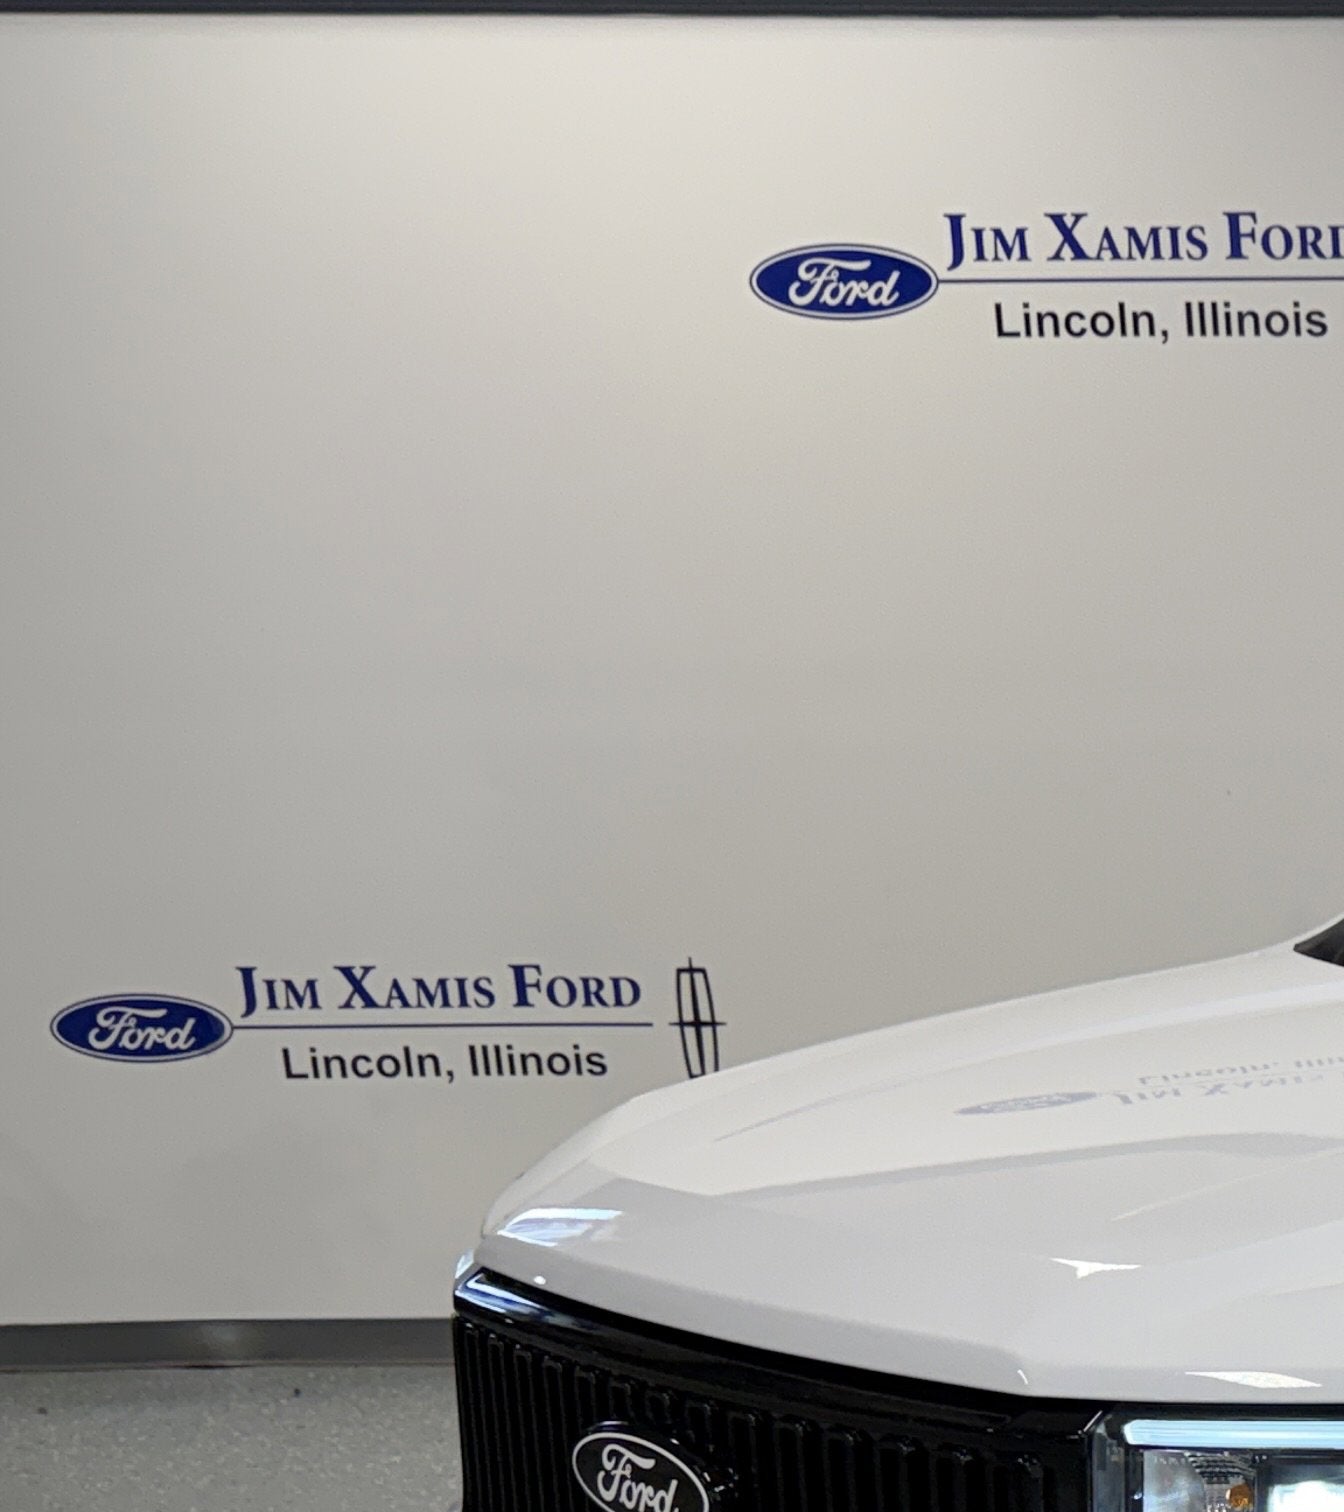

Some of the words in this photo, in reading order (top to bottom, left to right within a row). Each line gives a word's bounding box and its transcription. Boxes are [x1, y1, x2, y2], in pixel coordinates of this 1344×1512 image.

[943, 213, 1031, 272] JIM
[1044, 212, 1209, 262] XAMIS
[787, 255, 900, 309] Ford
[994, 301, 1169, 345] Lincoln,
[1184, 301, 1328, 338] Illinois
[235, 966, 322, 1019] JIM
[333, 965, 496, 1011] XAMIS
[507, 964, 641, 1009] FORD
[87, 1003, 197, 1052] Ford
[281, 1045, 454, 1084] Lincoln,
[468, 1044, 608, 1077] Illinois
